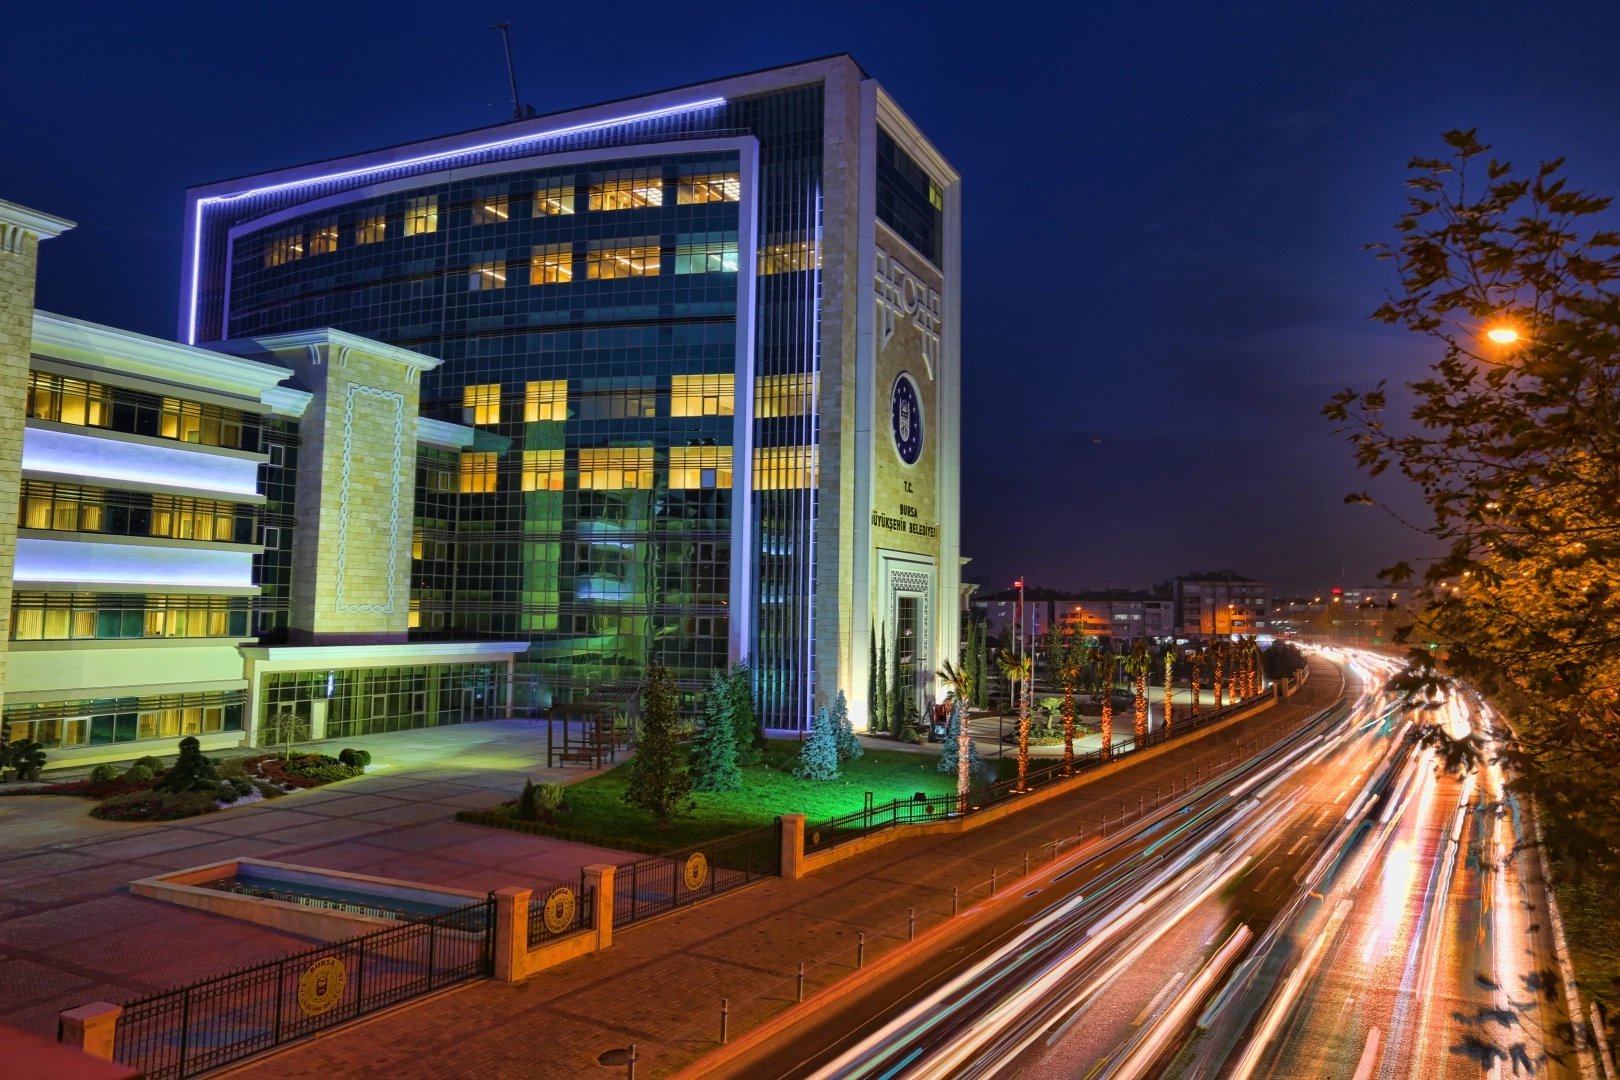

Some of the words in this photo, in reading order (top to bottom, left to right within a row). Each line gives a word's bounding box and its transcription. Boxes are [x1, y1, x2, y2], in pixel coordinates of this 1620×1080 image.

[904, 481, 913, 494] T.C.
[900, 503, 918, 518] BURSA
[310, 959, 335, 973] BURSA
